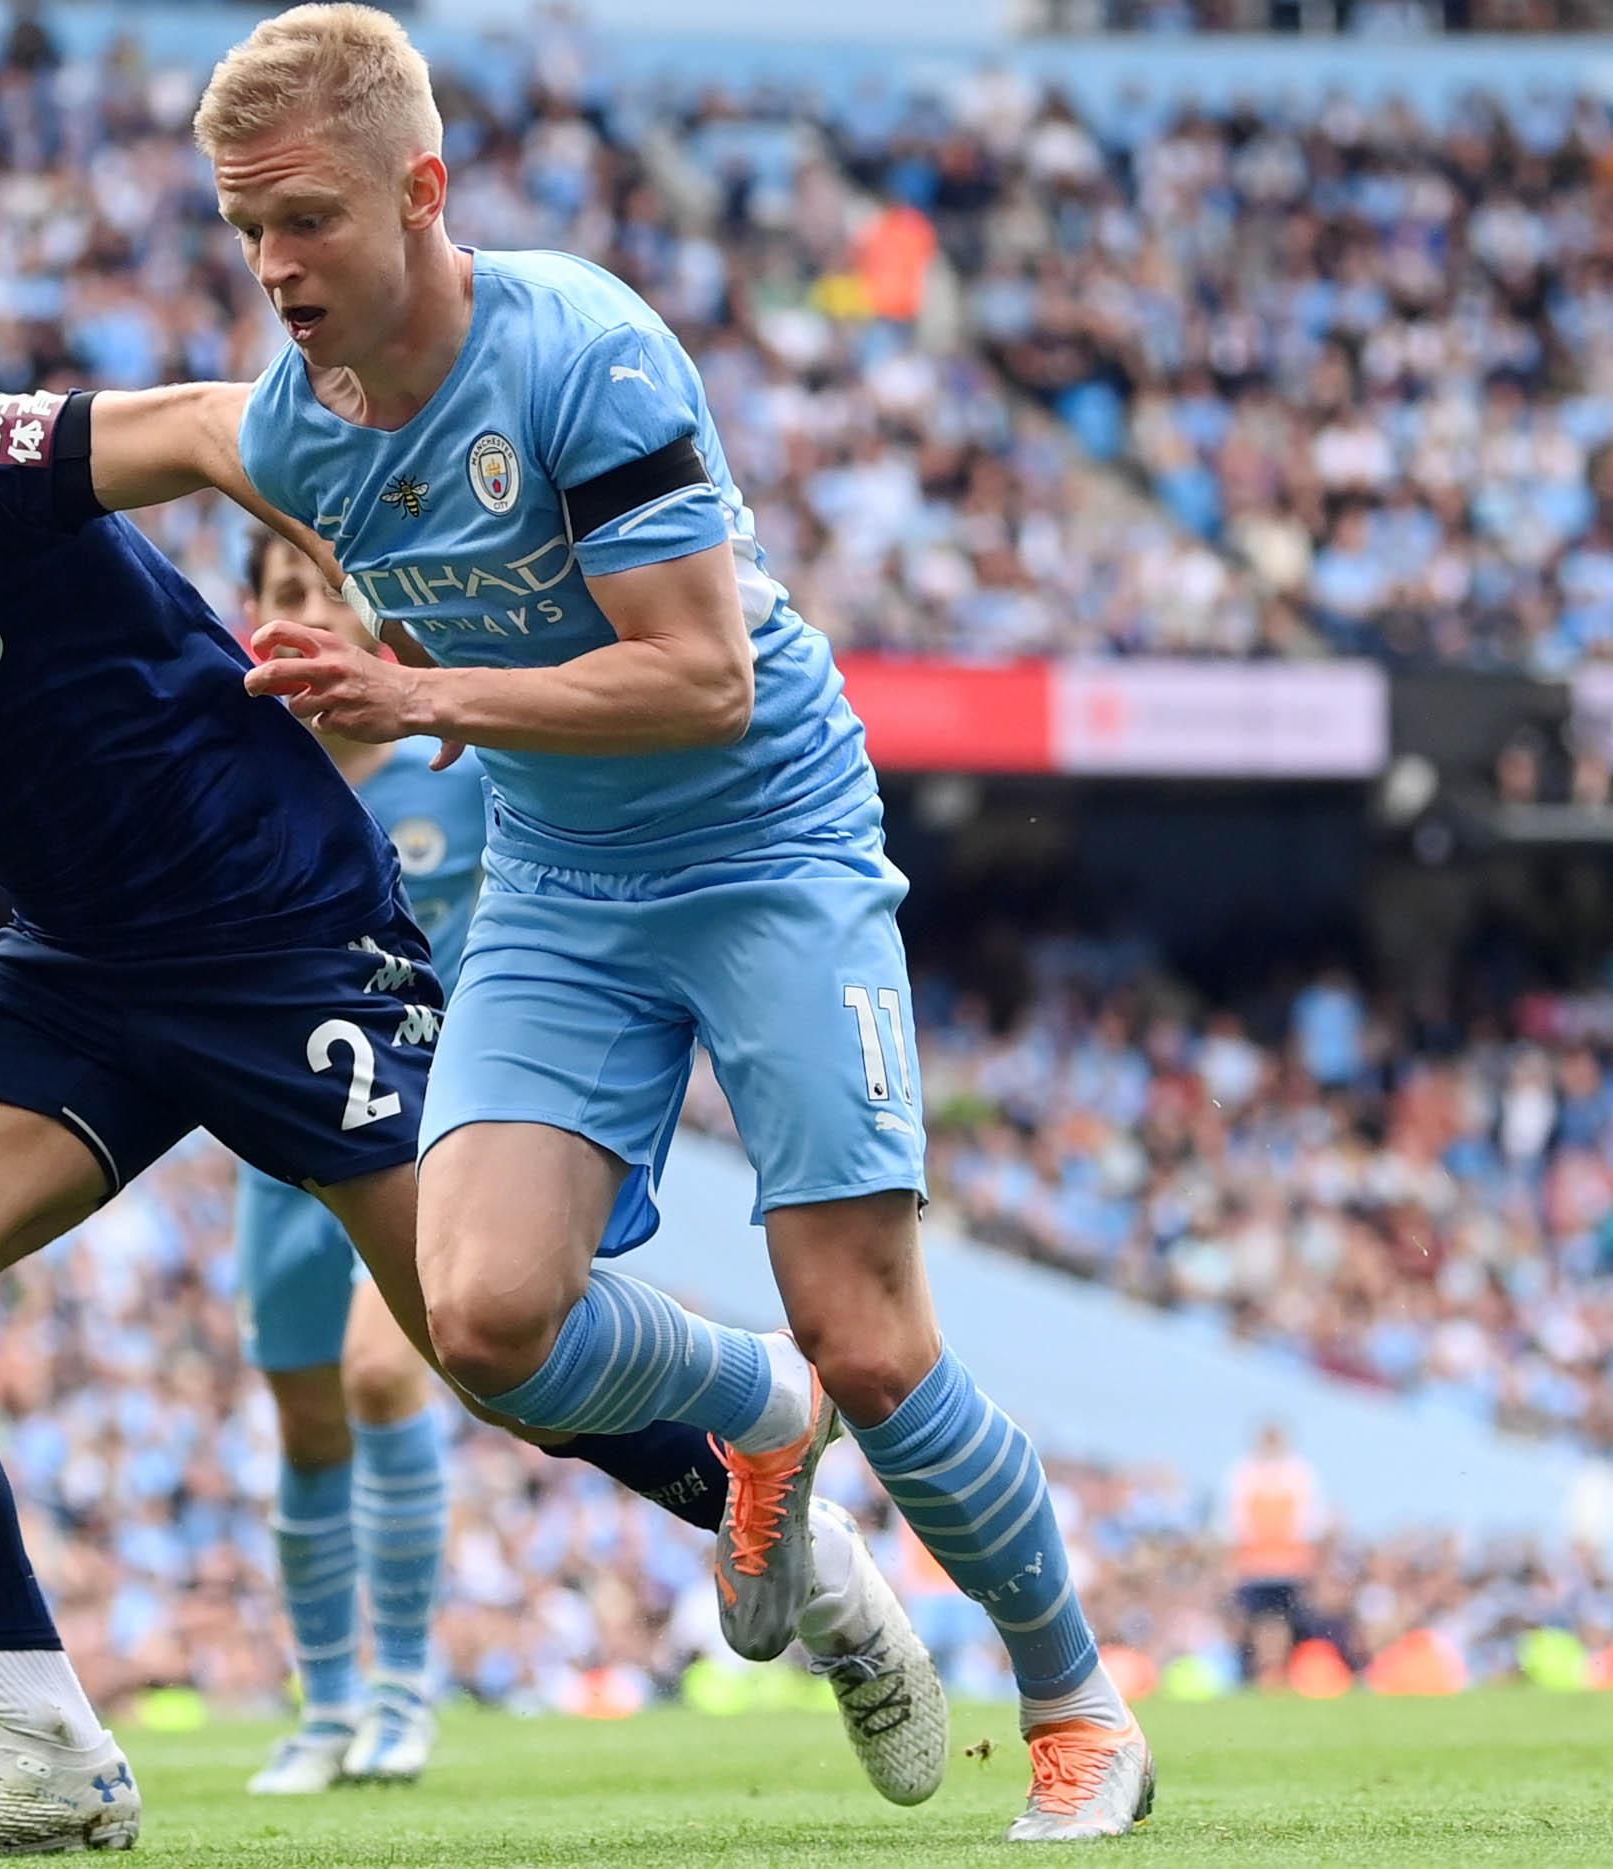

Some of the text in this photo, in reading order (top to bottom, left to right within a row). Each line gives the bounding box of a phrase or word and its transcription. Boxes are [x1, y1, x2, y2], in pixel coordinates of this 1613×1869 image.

[471, 437, 513, 466] MANCHESTER
[493, 501, 508, 510] CITY
[356, 534, 576, 611] TIHAD
[305, 1018, 402, 1132] 2
[842, 984, 913, 1106] 11
